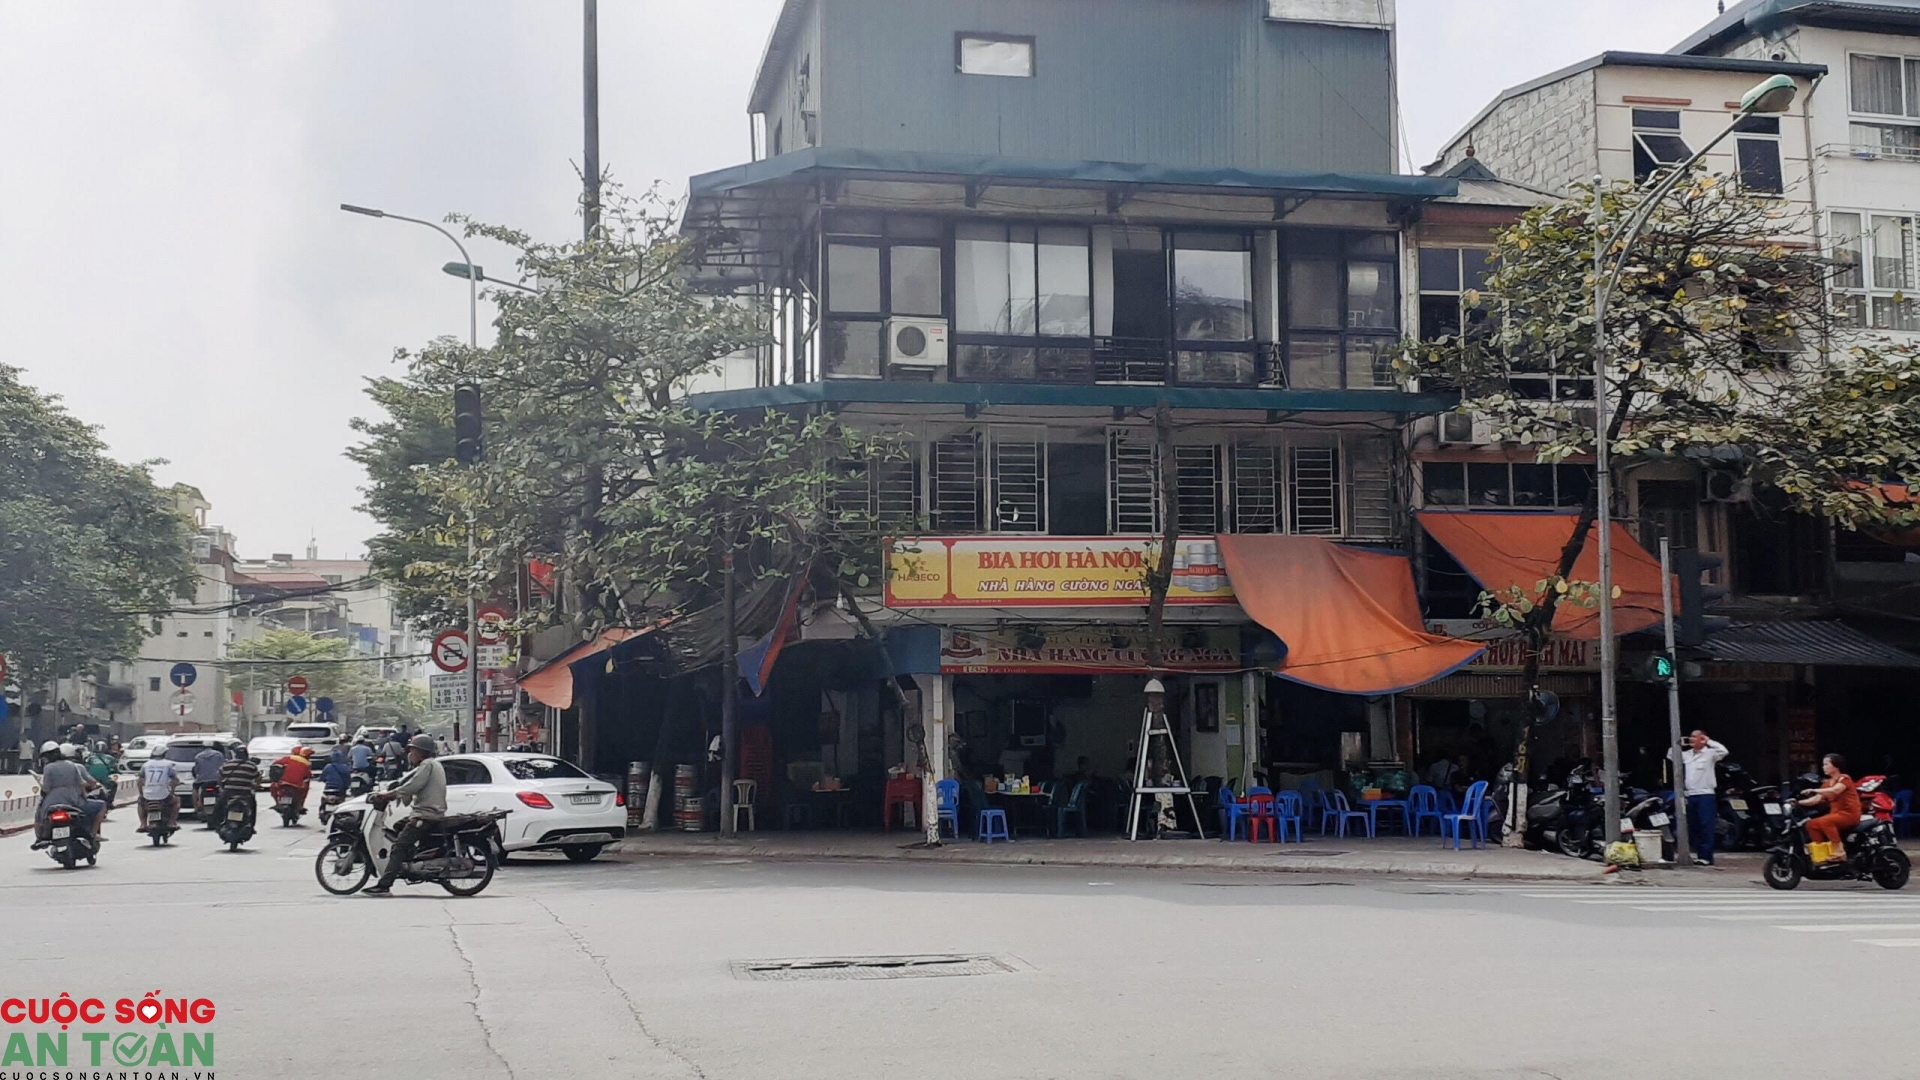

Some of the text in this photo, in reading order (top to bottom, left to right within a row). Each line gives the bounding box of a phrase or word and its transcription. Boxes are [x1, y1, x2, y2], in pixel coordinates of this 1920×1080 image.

[978, 546, 1144, 572] BIA HƠI HÀ NỘI
[898, 573, 940, 582] HABECO
[978, 576, 1143, 592] NHÀ HÀNG CƯỜNG NGA
[1558, 640, 1586, 666] MAI
[148, 769, 164, 783] 77
